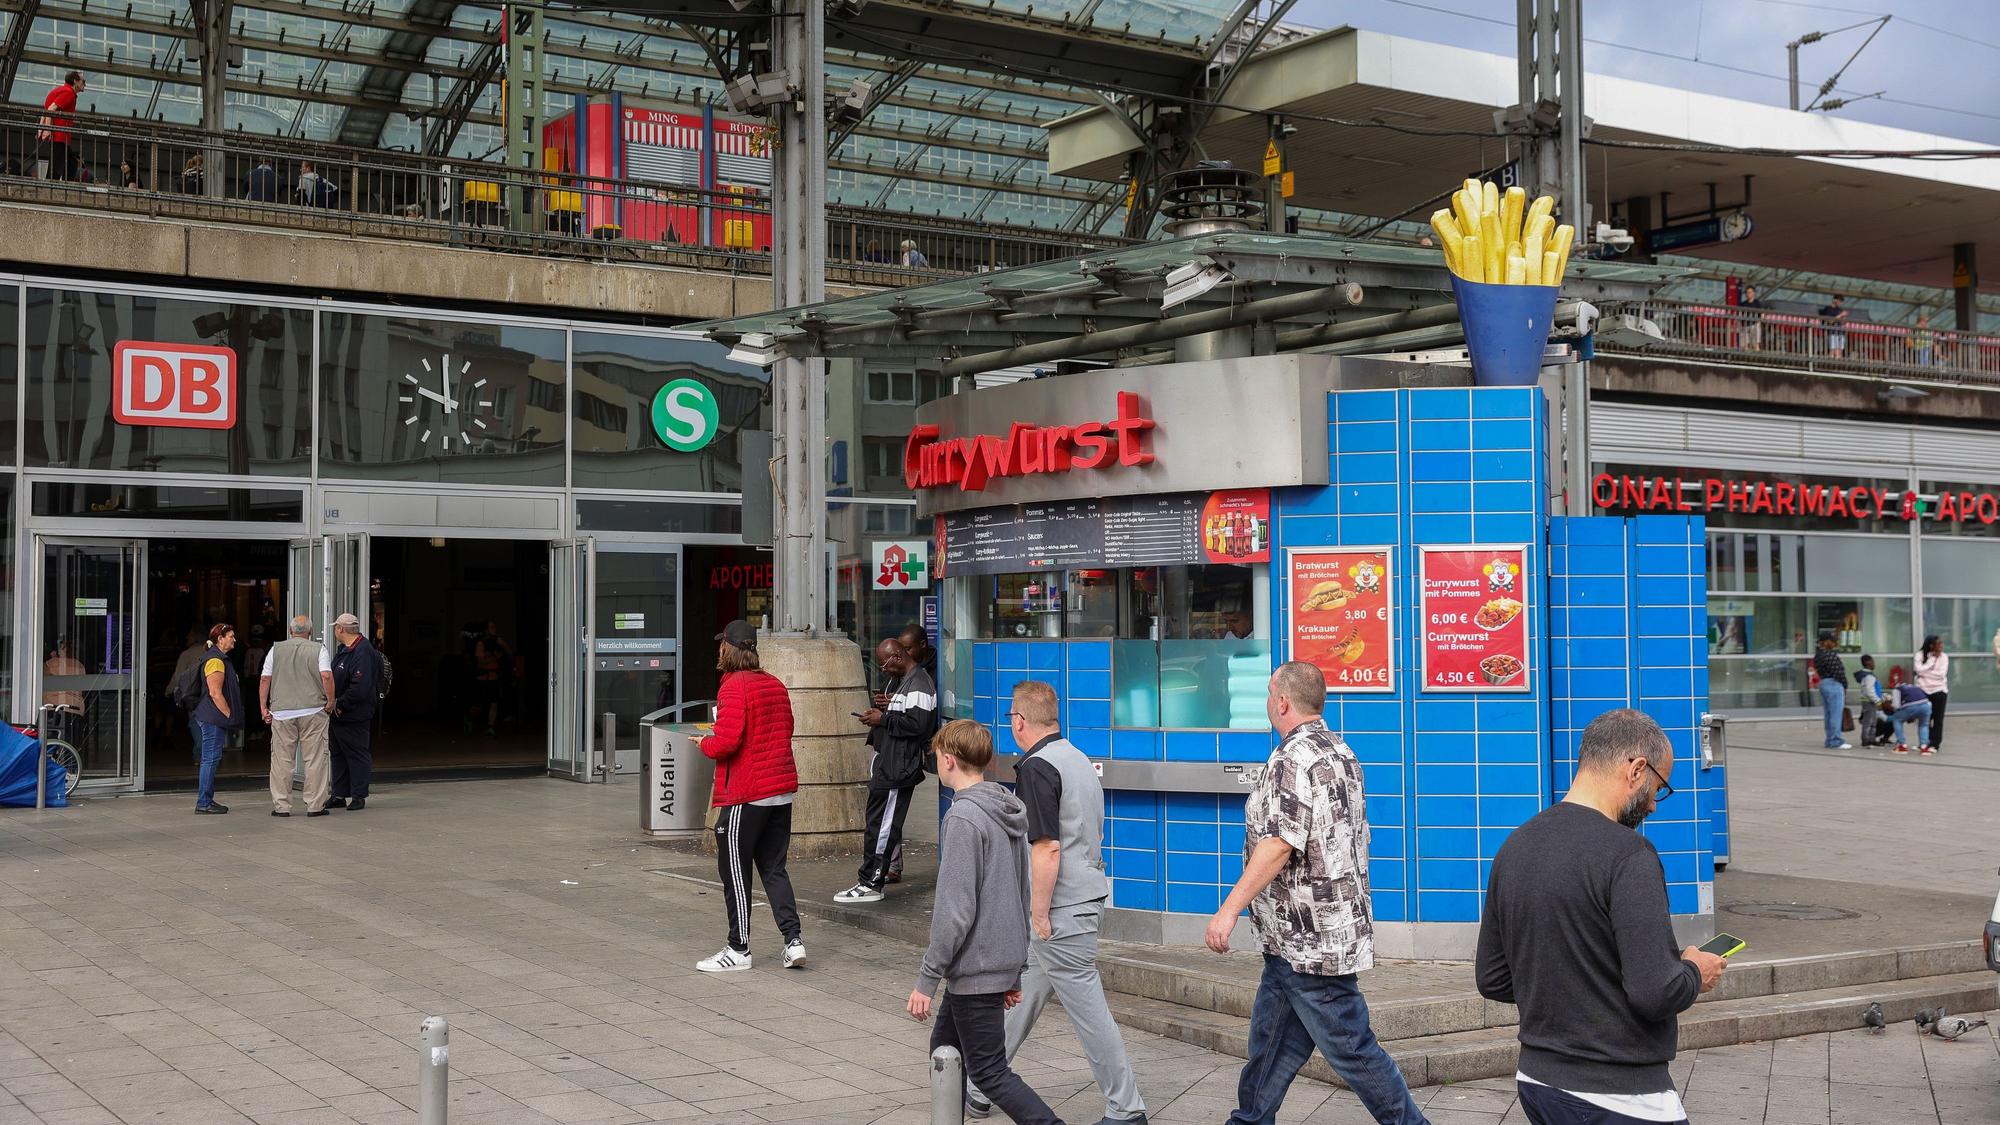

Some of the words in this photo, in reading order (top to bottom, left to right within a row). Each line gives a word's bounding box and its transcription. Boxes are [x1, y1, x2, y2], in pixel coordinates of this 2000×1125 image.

[648, 112, 679, 125] MING
[130, 354, 222, 414] DB
[665, 386, 706, 444] S
[905, 391, 1155, 491] Currywurst
[1592, 473, 1692, 512] ONAL
[1705, 479, 1889, 520] PHARMACY
[1937, 491, 2000, 525] APO
[1296, 561, 1339, 570] Bratwurst
[1425, 579, 1480, 590] Currywurst
[1442, 590, 1480, 598] Pommes
[1345, 610, 1367, 621] 3,80
[1376, 607, 1387, 620] €
[1431, 613, 1457, 626] 6,00
[1460, 613, 1468, 624] €
[1298, 625, 1339, 633] Krakauer
[1428, 632, 1489, 643] Currywurst
[1450, 643, 1484, 651] Brötchen
[1339, 669, 1372, 684] 4,00
[1377, 669, 1387, 682] €
[1436, 671, 1463, 684] 4,50
[1466, 671, 1475, 683] €
[660, 758, 675, 816] Abfall
